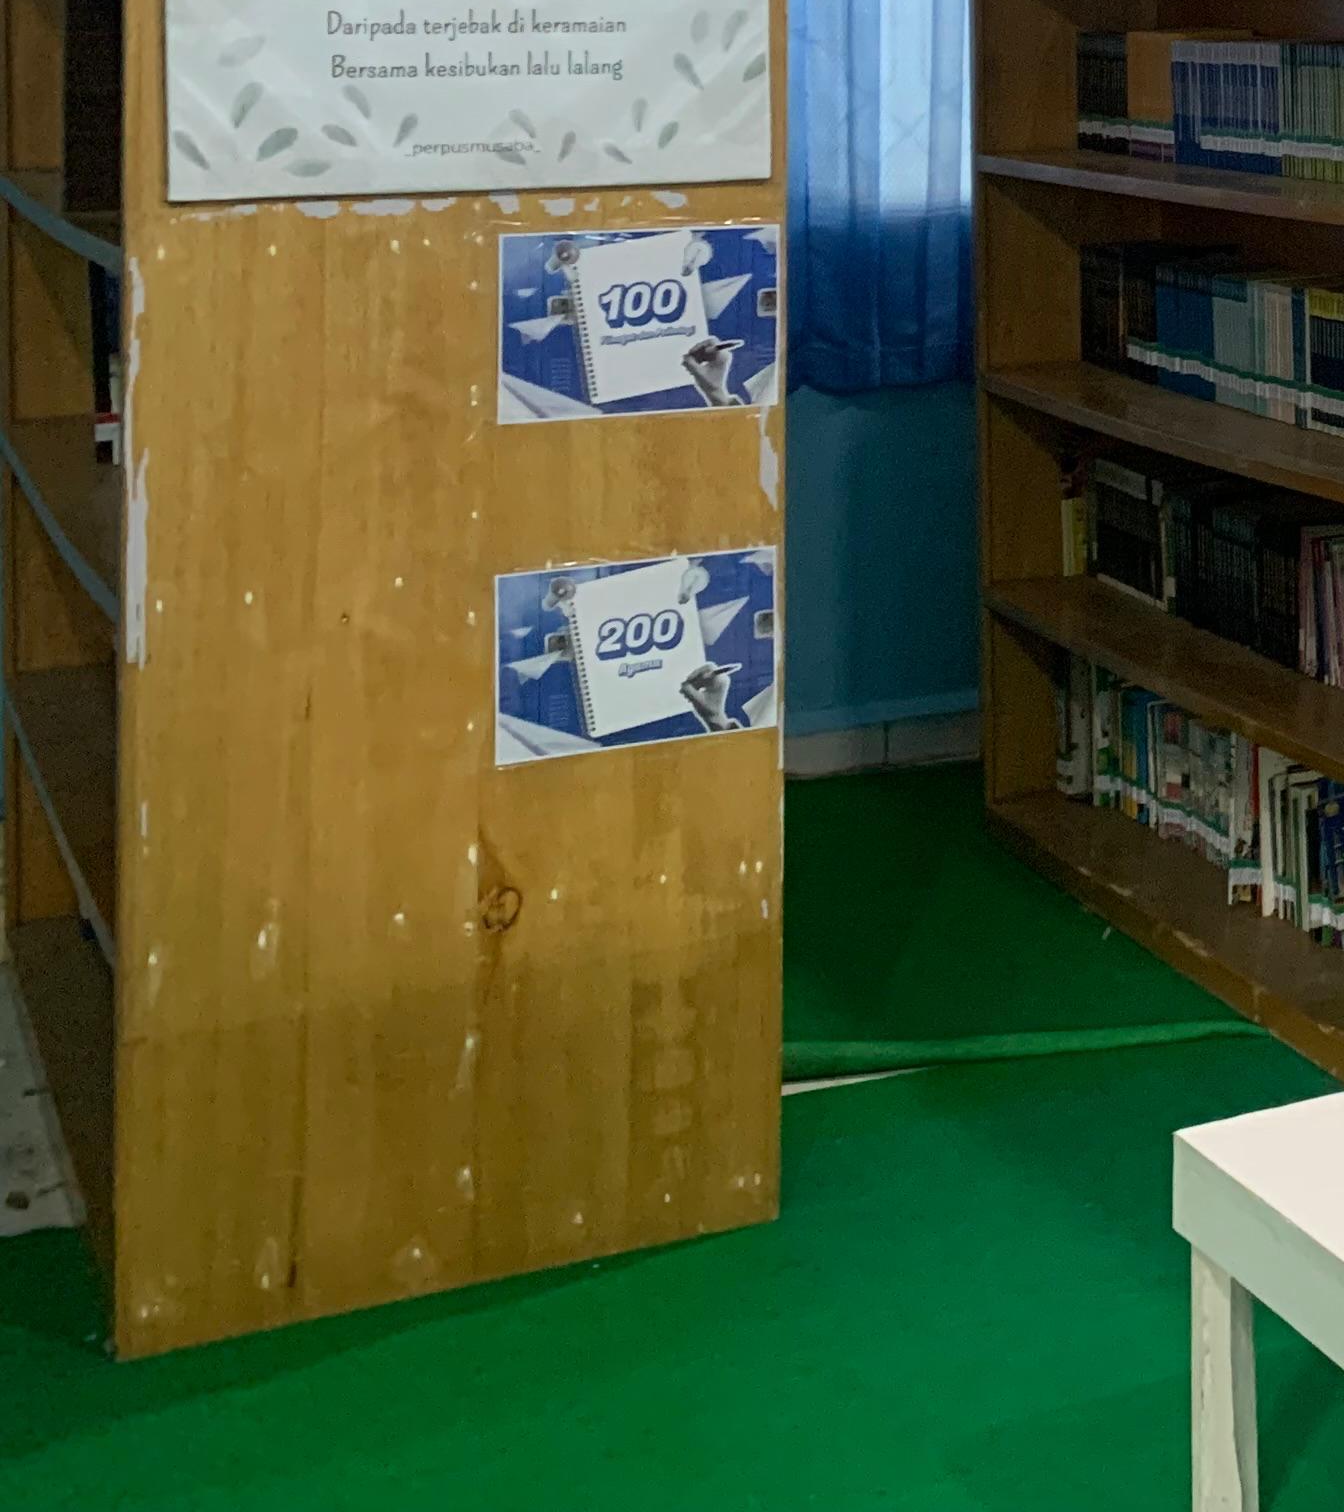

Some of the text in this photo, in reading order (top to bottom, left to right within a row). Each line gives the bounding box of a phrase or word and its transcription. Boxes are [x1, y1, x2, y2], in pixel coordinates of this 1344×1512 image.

[327, 8, 627, 41] Daripada terjebak di keramaian
[331, 50, 623, 81] Bersama kesibukan lalu lalang
[598, 279, 688, 328] 100
[595, 609, 685, 661] 200
